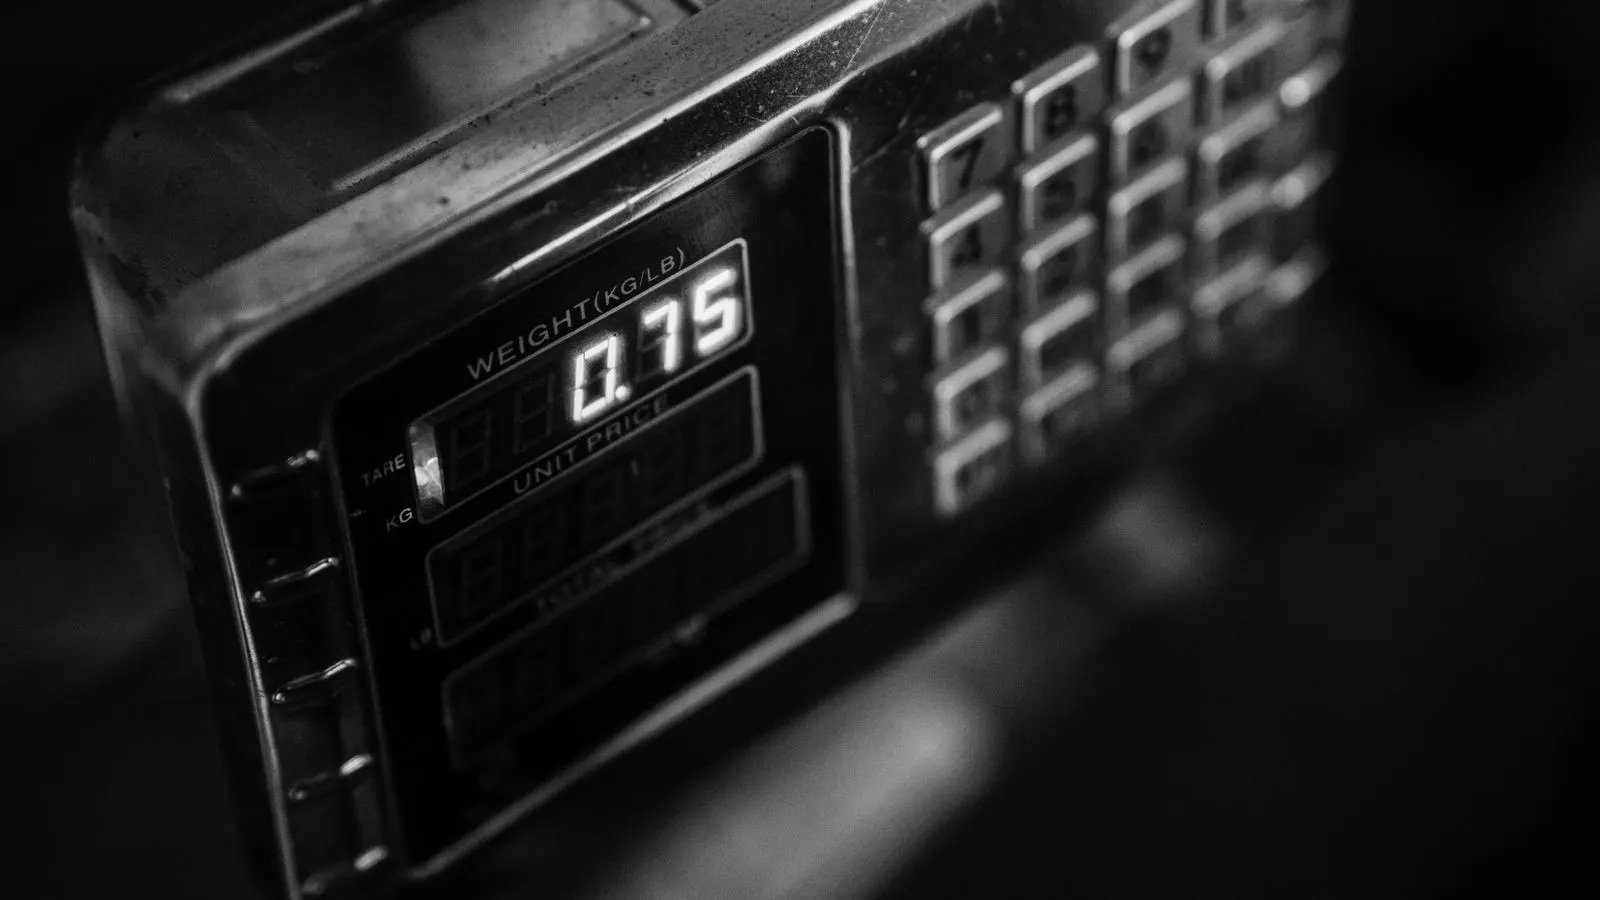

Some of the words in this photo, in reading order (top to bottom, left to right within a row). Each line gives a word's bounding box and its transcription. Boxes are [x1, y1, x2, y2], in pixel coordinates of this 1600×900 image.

[952, 139, 984, 190] 7
[466, 246, 686, 382] WEIGHT(KG/LB)
[569, 266, 741, 422] 0.75
[361, 452, 406, 488] TARE
[512, 444, 578, 496] UNIT
[585, 394, 669, 453] PRICE
[385, 506, 414, 533] KG
